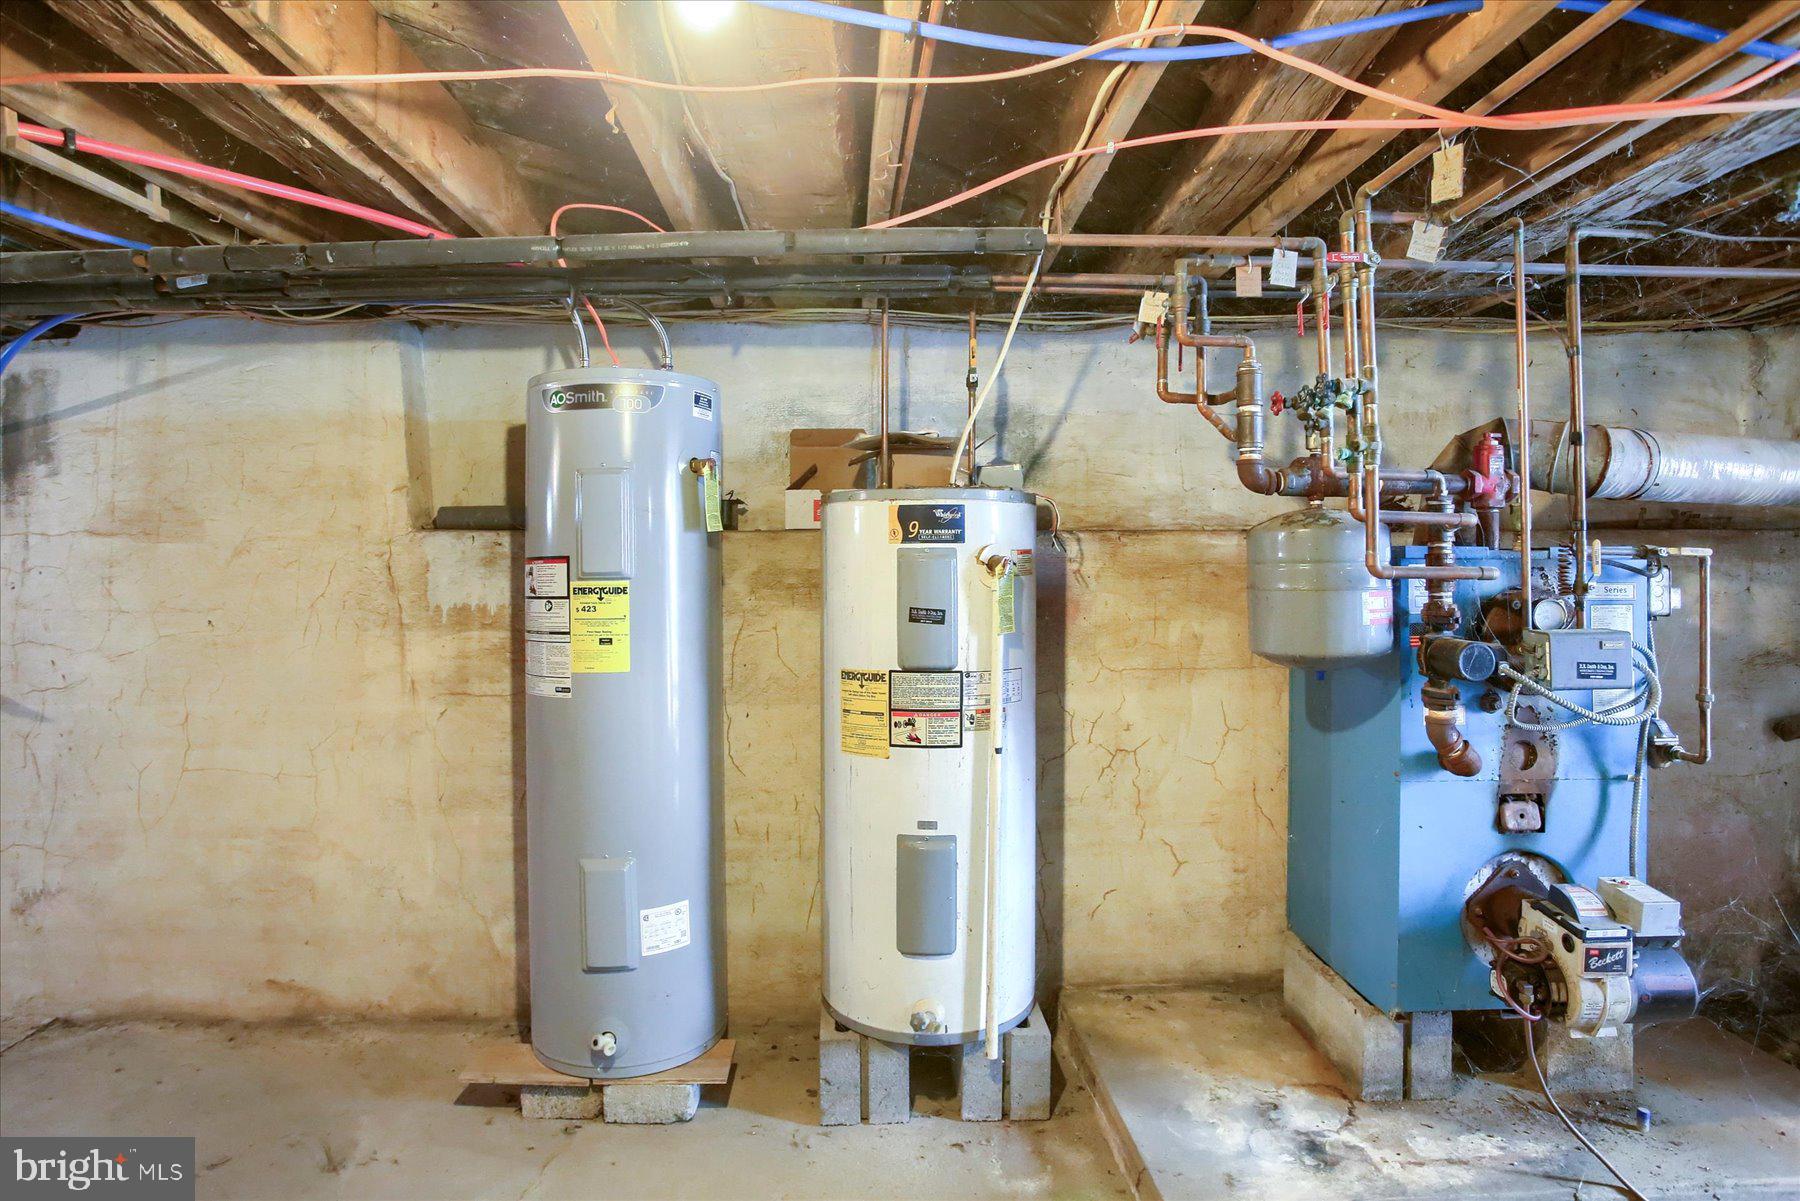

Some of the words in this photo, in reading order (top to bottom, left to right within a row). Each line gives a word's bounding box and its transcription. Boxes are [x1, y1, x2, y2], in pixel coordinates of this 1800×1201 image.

[908, 520, 919, 538] 9
[1603, 586, 1628, 594] Series
[581, 605, 597, 613] 423
[1588, 949, 1625, 969] Beckett
